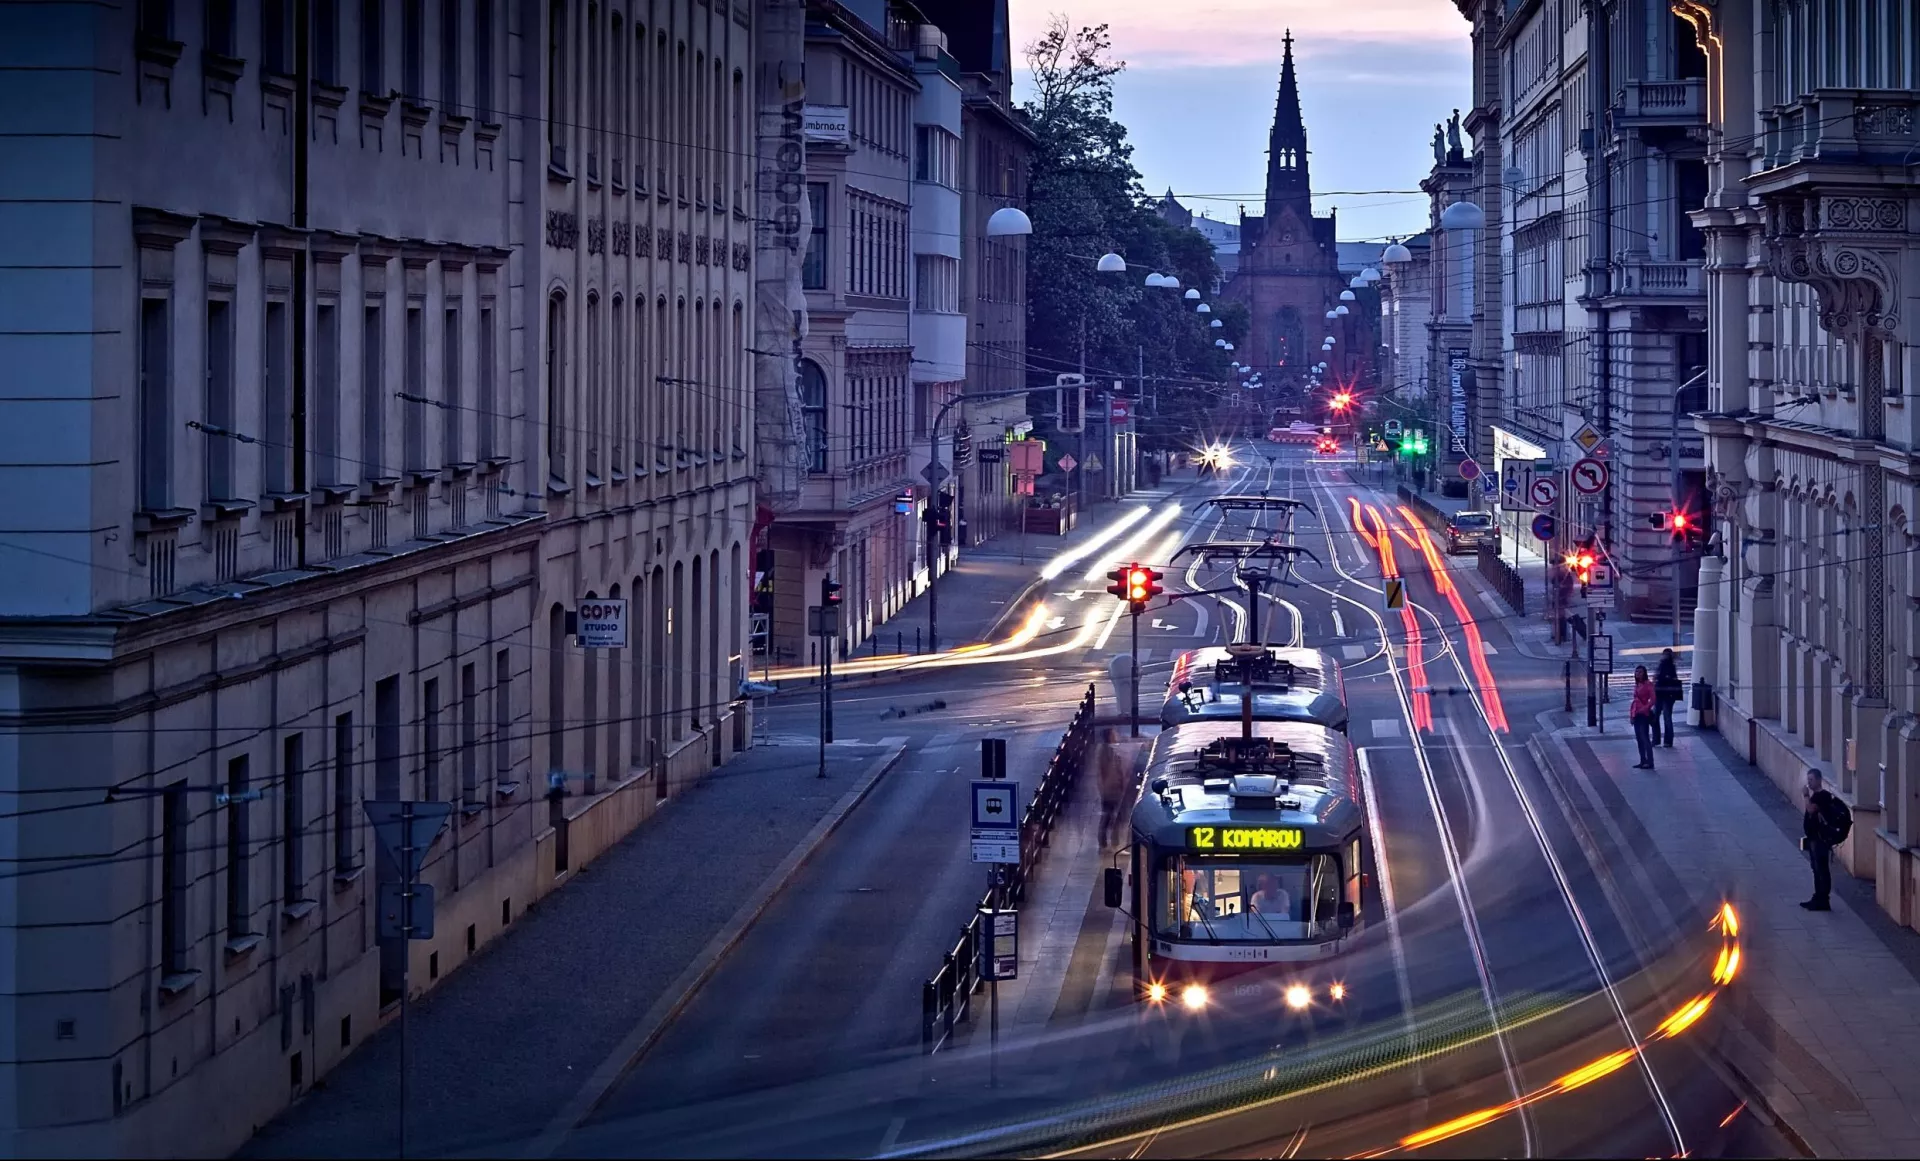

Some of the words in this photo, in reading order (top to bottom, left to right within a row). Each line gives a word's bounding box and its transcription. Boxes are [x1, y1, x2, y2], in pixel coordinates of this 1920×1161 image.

[772, 99, 805, 257] weber
[581, 605, 621, 620] COPY
[584, 623, 618, 631] STUDIO
[1193, 827, 1214, 847] 12
[1223, 828, 1300, 848] KOMÁROV
